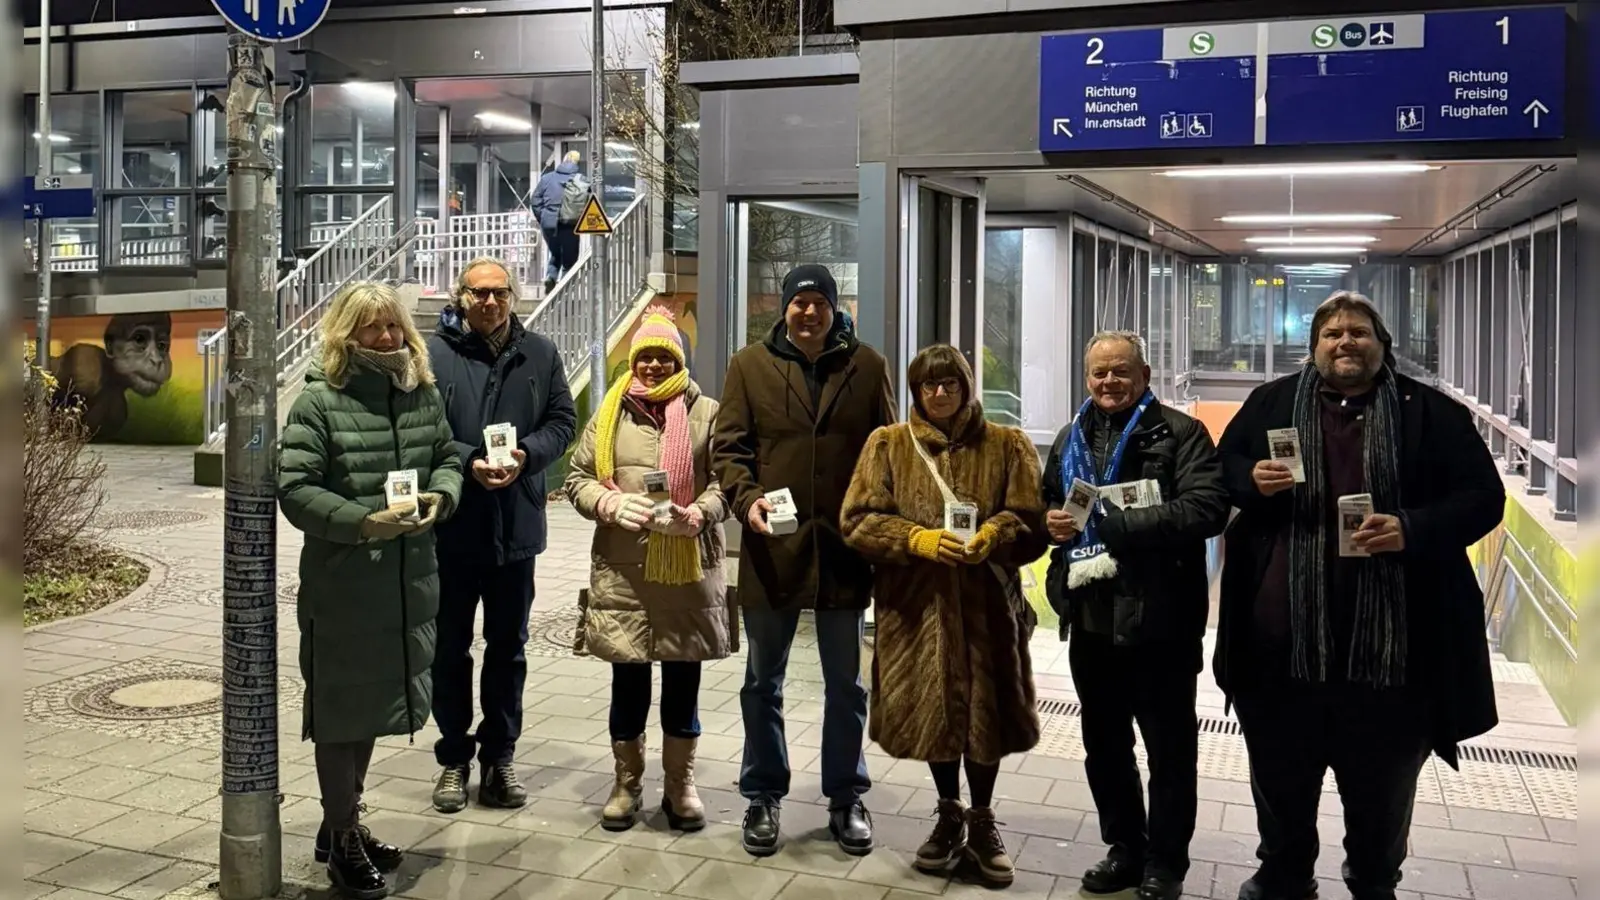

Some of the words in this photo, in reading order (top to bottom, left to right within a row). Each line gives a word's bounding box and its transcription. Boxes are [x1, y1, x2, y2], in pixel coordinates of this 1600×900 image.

[1344, 30, 1363, 40] Bus
[1495, 16, 1509, 45] 1
[1085, 37, 1105, 65] 2
[1448, 70, 1508, 84] Richtung
[1085, 85, 1136, 98] Richtung
[1455, 87, 1508, 101] Freising
[1085, 101, 1138, 113] München
[1441, 103, 1508, 120] Flughafen
[1071, 545, 1097, 558] CSU
